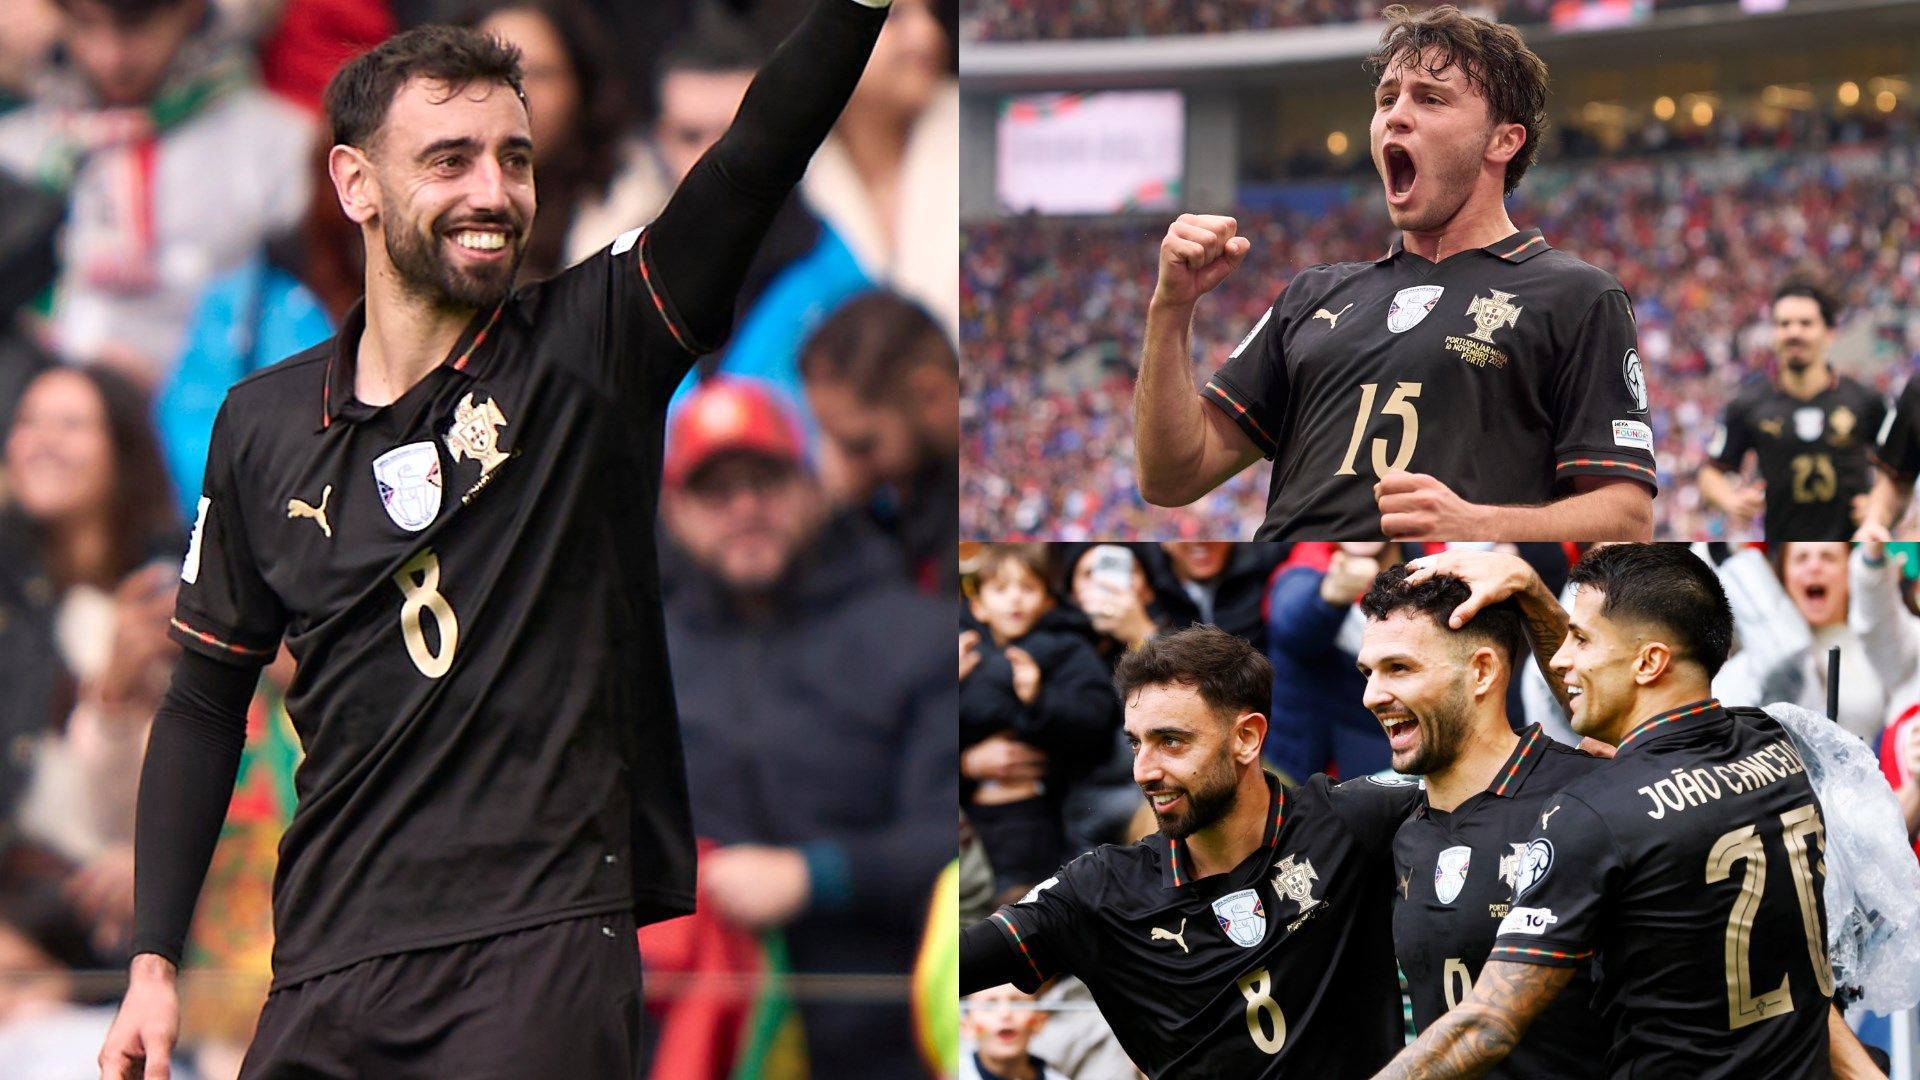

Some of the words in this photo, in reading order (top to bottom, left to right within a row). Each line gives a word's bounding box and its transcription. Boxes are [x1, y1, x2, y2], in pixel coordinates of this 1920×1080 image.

[1452, 344, 1489, 361] NOVEMBRO
[1461, 352, 1486, 368] PORTO
[1334, 382, 1422, 480] 15
[393, 546, 459, 679] 8
[1638, 767, 1721, 820] JOÃO
[1236, 965, 1287, 1055] 8
